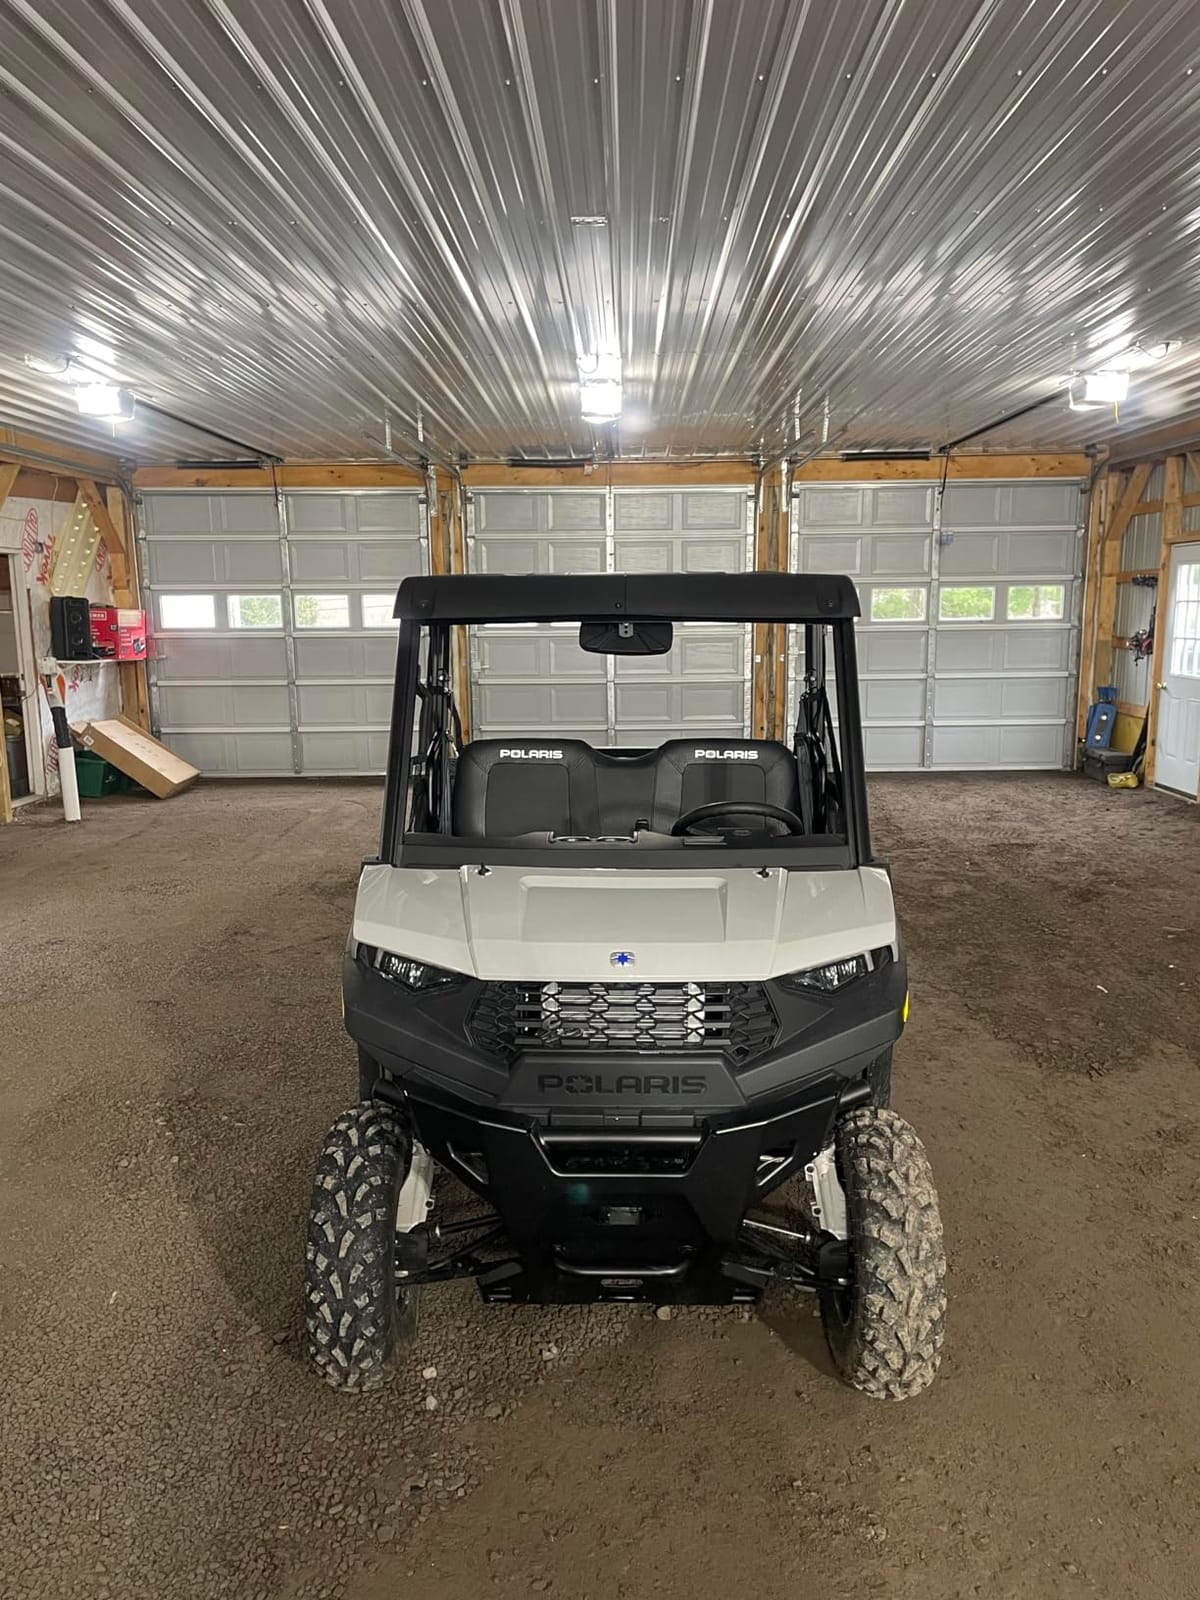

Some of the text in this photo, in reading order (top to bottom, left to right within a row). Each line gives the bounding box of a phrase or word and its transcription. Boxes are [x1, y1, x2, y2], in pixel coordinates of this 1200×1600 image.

[36, 534, 55, 584] Tyvek
[500, 749, 563, 759] POLARIS
[694, 749, 759, 760] POLARIS
[537, 1074, 708, 1095] POLARIS
